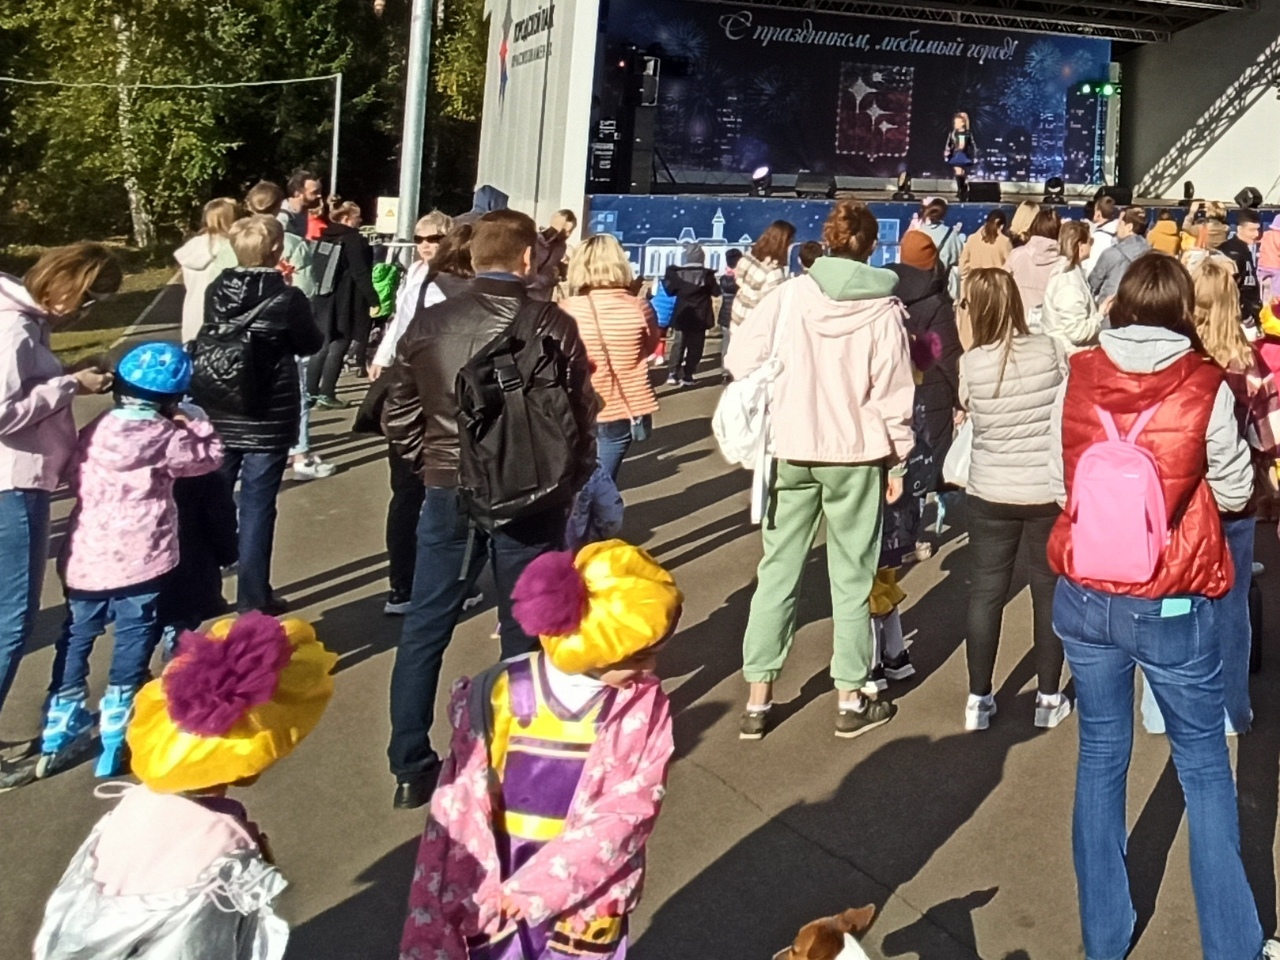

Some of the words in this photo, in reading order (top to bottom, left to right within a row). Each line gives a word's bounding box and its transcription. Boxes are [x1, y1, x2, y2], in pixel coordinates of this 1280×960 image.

[718, 10, 753, 40] С
[753, 18, 870, 52] праздником,
[875, 29, 965, 56] любимый
[967, 36, 1019, 65] город!
